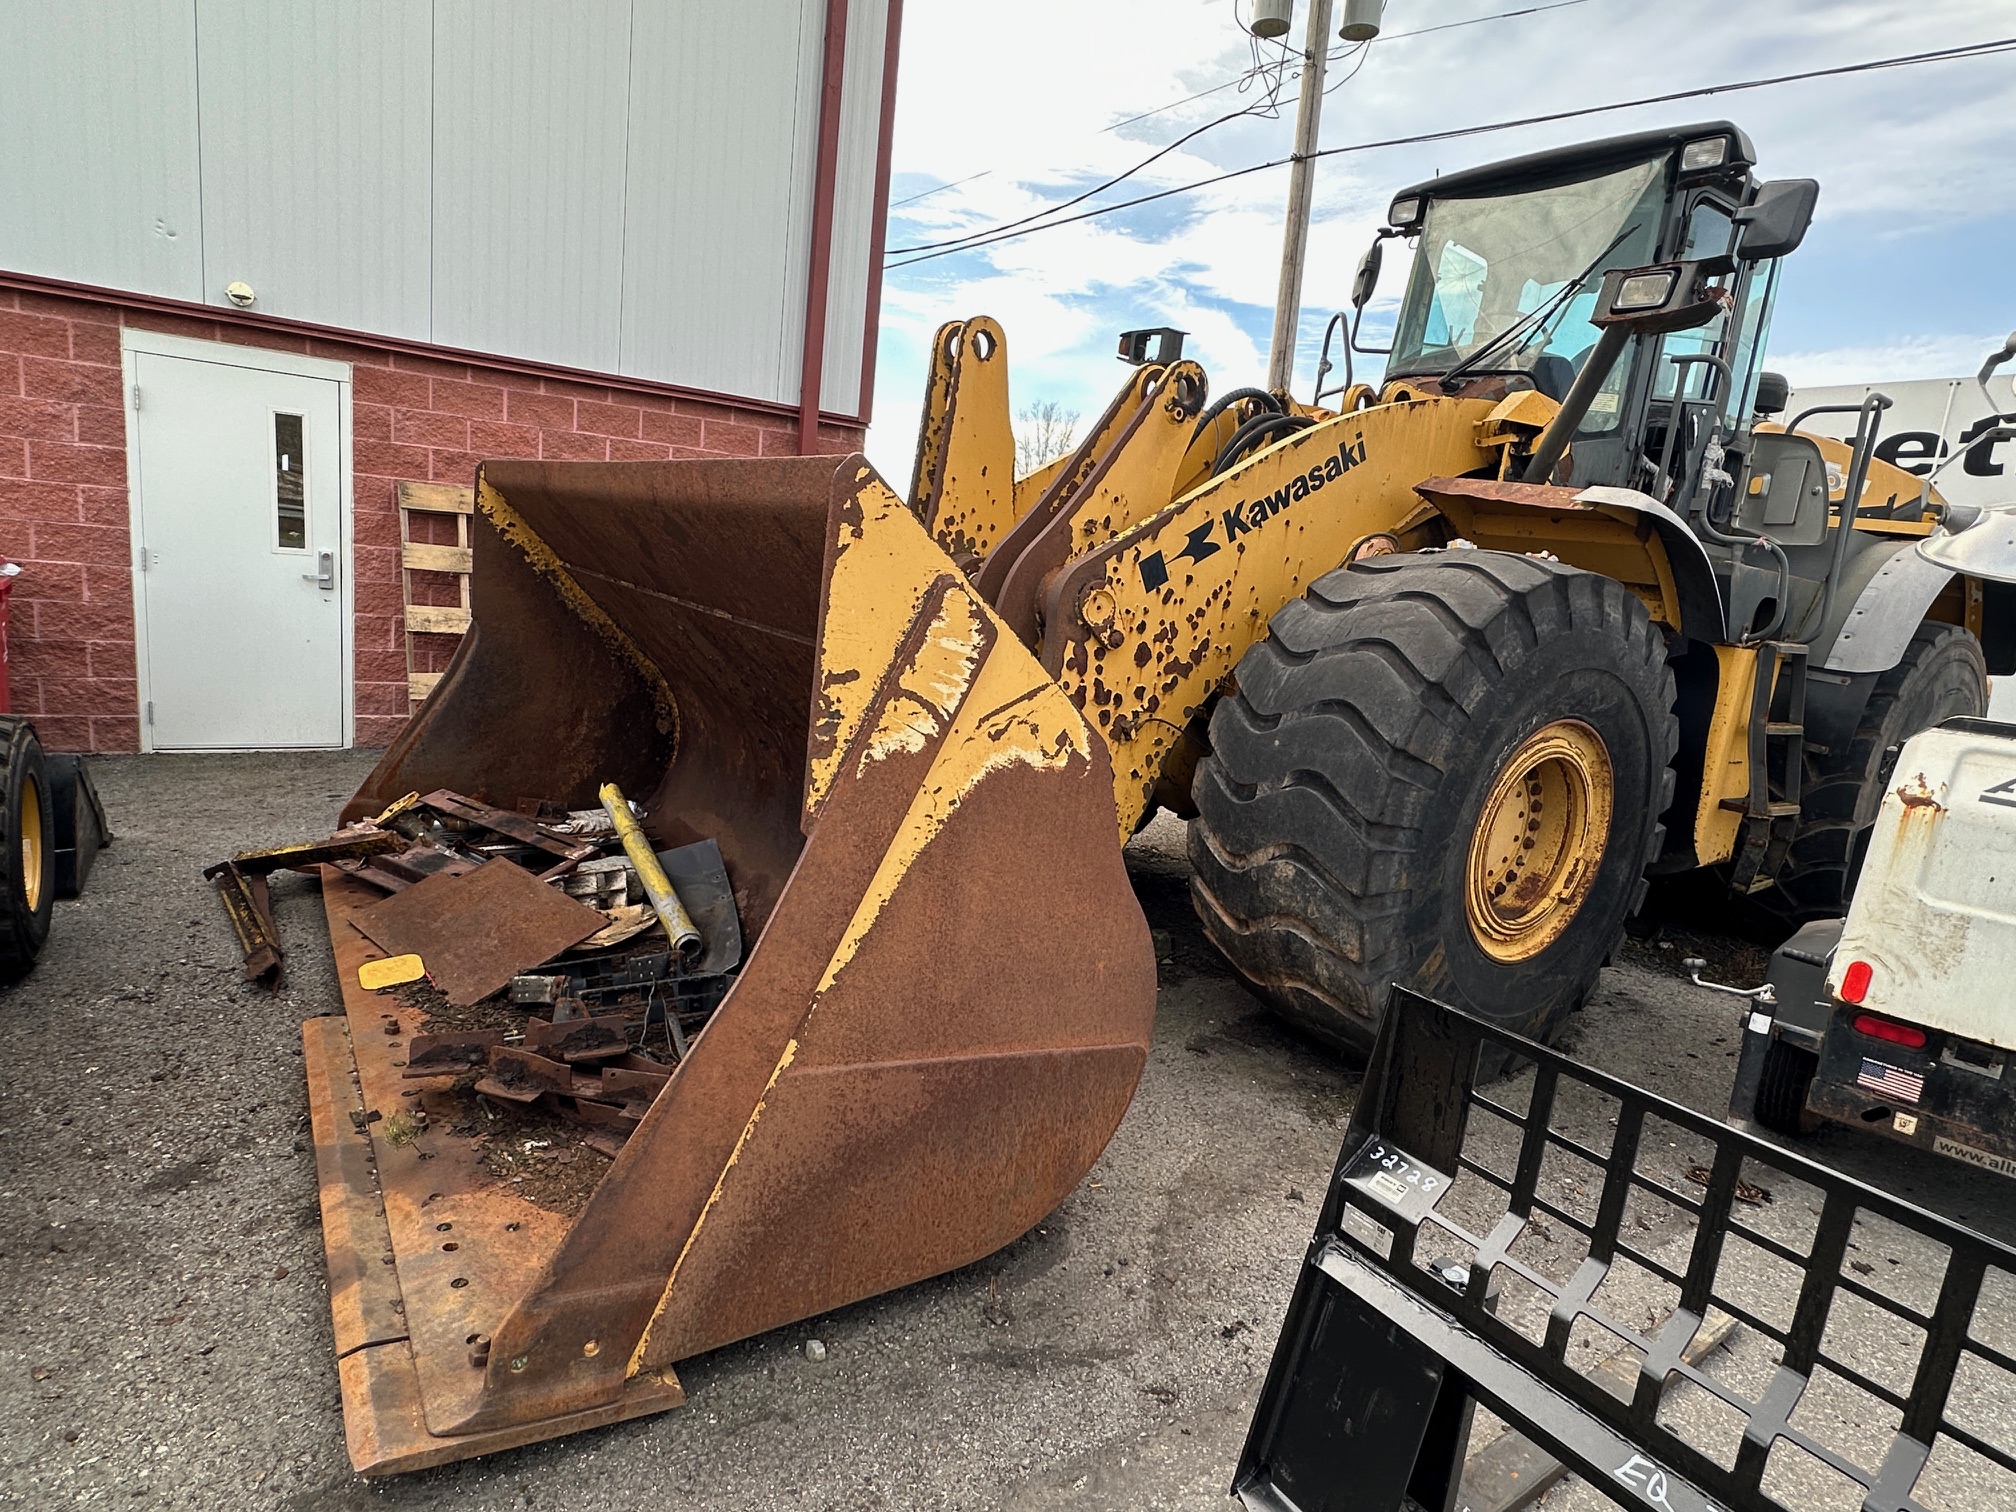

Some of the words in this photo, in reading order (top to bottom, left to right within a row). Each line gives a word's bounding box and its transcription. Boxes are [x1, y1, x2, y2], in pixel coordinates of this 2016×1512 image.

[1222, 432, 1367, 543] Kawasaki
[1370, 1146, 1439, 1192] 32728
[1612, 1454, 1675, 1512] EQ
